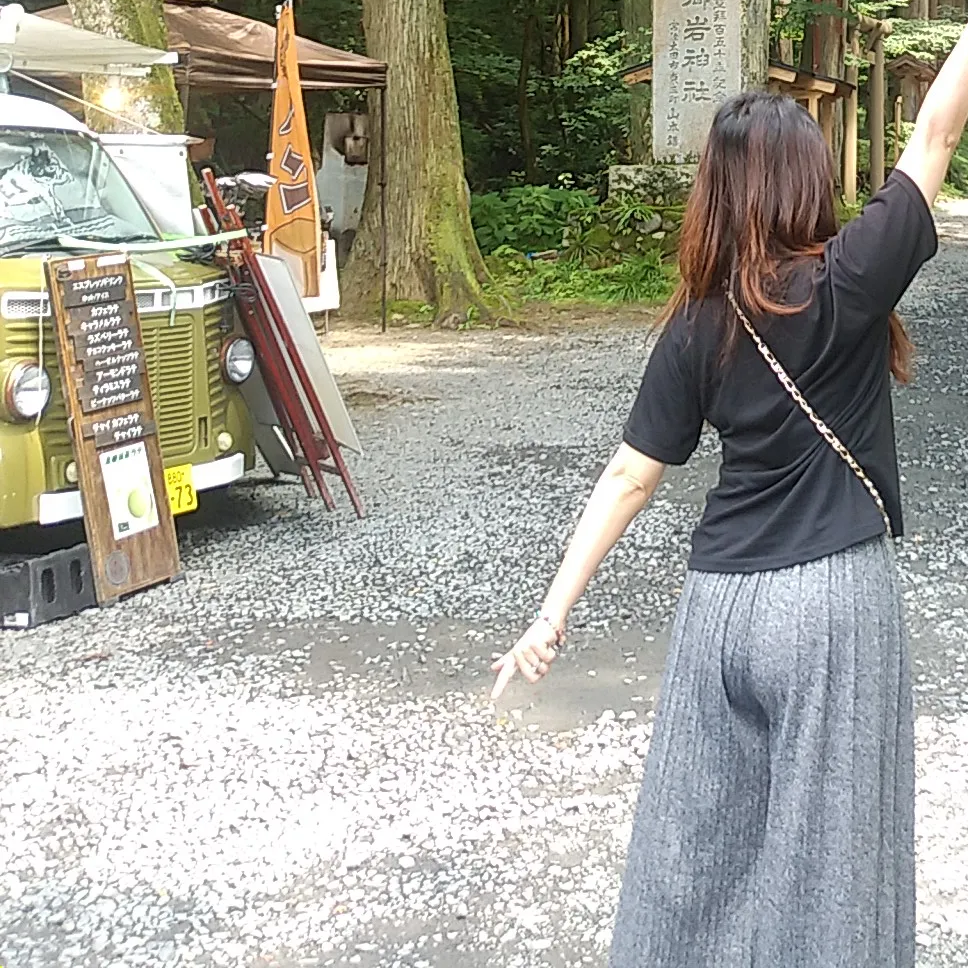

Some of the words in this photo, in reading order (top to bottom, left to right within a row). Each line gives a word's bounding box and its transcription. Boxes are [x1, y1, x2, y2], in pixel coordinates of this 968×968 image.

[90, 303, 119, 317] カフェラテ
[80, 316, 122, 331] キャラメルラテ
[87, 328, 130, 344] ラズベリーラテ
[86, 339, 133, 357] チョコクッキーラテ
[95, 364, 138, 382] アーモンドラテ
[92, 378, 131, 396] ティラミスラテ
[113, 425, 143, 442] チャイラテ
